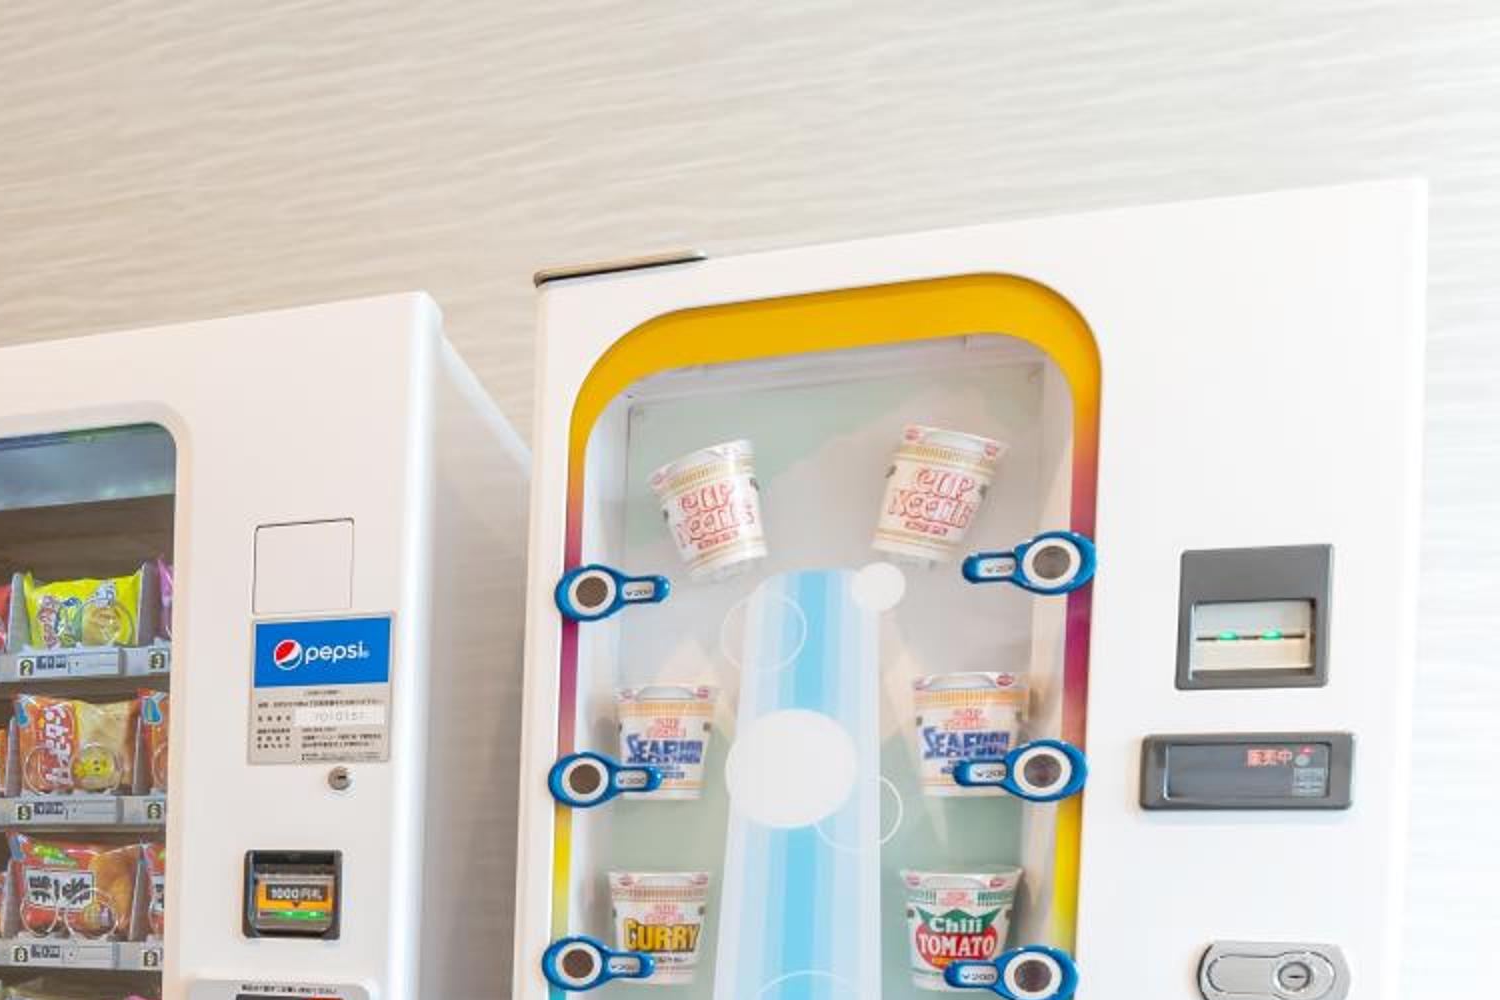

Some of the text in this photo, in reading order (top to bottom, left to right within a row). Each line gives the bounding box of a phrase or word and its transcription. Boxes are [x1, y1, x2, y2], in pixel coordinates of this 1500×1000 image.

[304, 640, 363, 665] pepsi
[623, 917, 700, 952] CURRY
[917, 932, 995, 958] TOMATO
